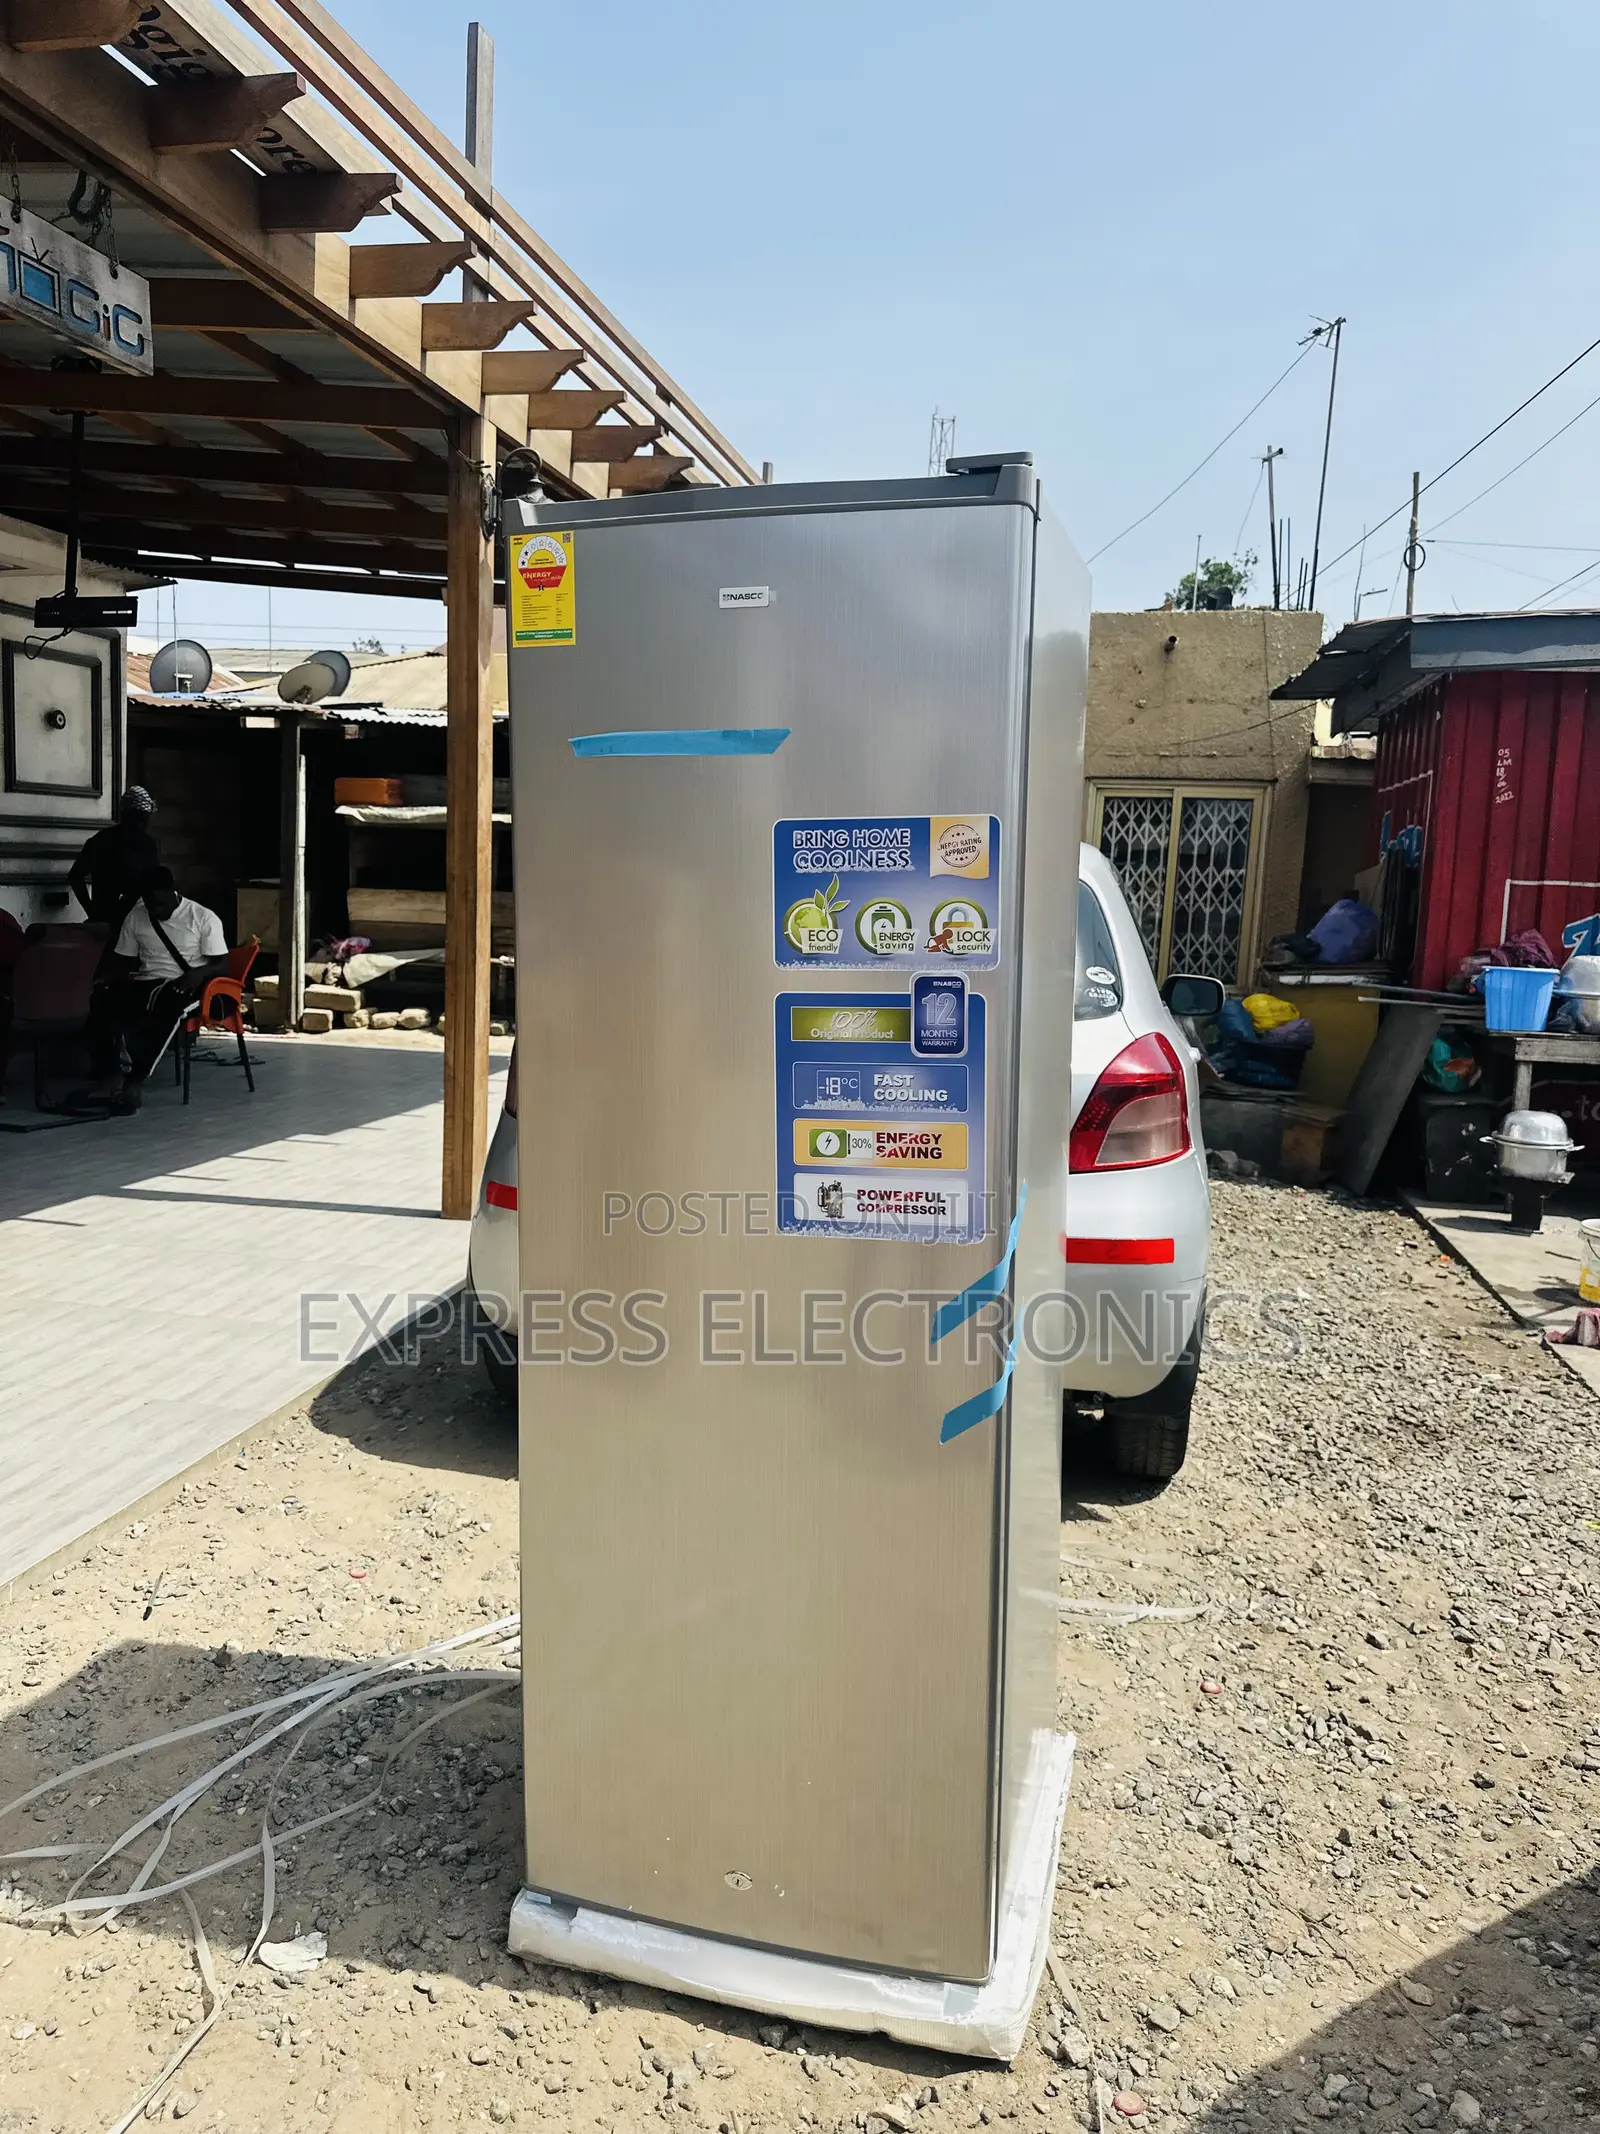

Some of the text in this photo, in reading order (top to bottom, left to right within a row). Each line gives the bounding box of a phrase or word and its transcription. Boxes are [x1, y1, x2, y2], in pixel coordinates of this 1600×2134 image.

[522, 571, 552, 580] ENERGY
[793, 828, 911, 849] BRING HOME
[944, 846, 977, 858] APPROVED
[794, 850, 910, 870] COOLNESS
[808, 930, 839, 942] ECO
[879, 931, 916, 942] ENERGY
[957, 930, 991, 942] LOCK
[808, 943, 839, 954] friendly
[879, 942, 915, 952] saving
[957, 942, 992, 952] security
[921, 993, 957, 1026] 12
[810, 1028, 895, 1040] Original Product
[921, 1030, 958, 1038] MONTHS
[873, 1073, 915, 1087] FAST
[873, 1089, 948, 1102] COOLING
[851, 1137, 872, 1150] 30%
[876, 1132, 943, 1145] ENERGY
[876, 1145, 943, 1160] SAVING
[857, 1189, 947, 1203] POWERFUL
[857, 1203, 947, 1216] COMPRESSOR
